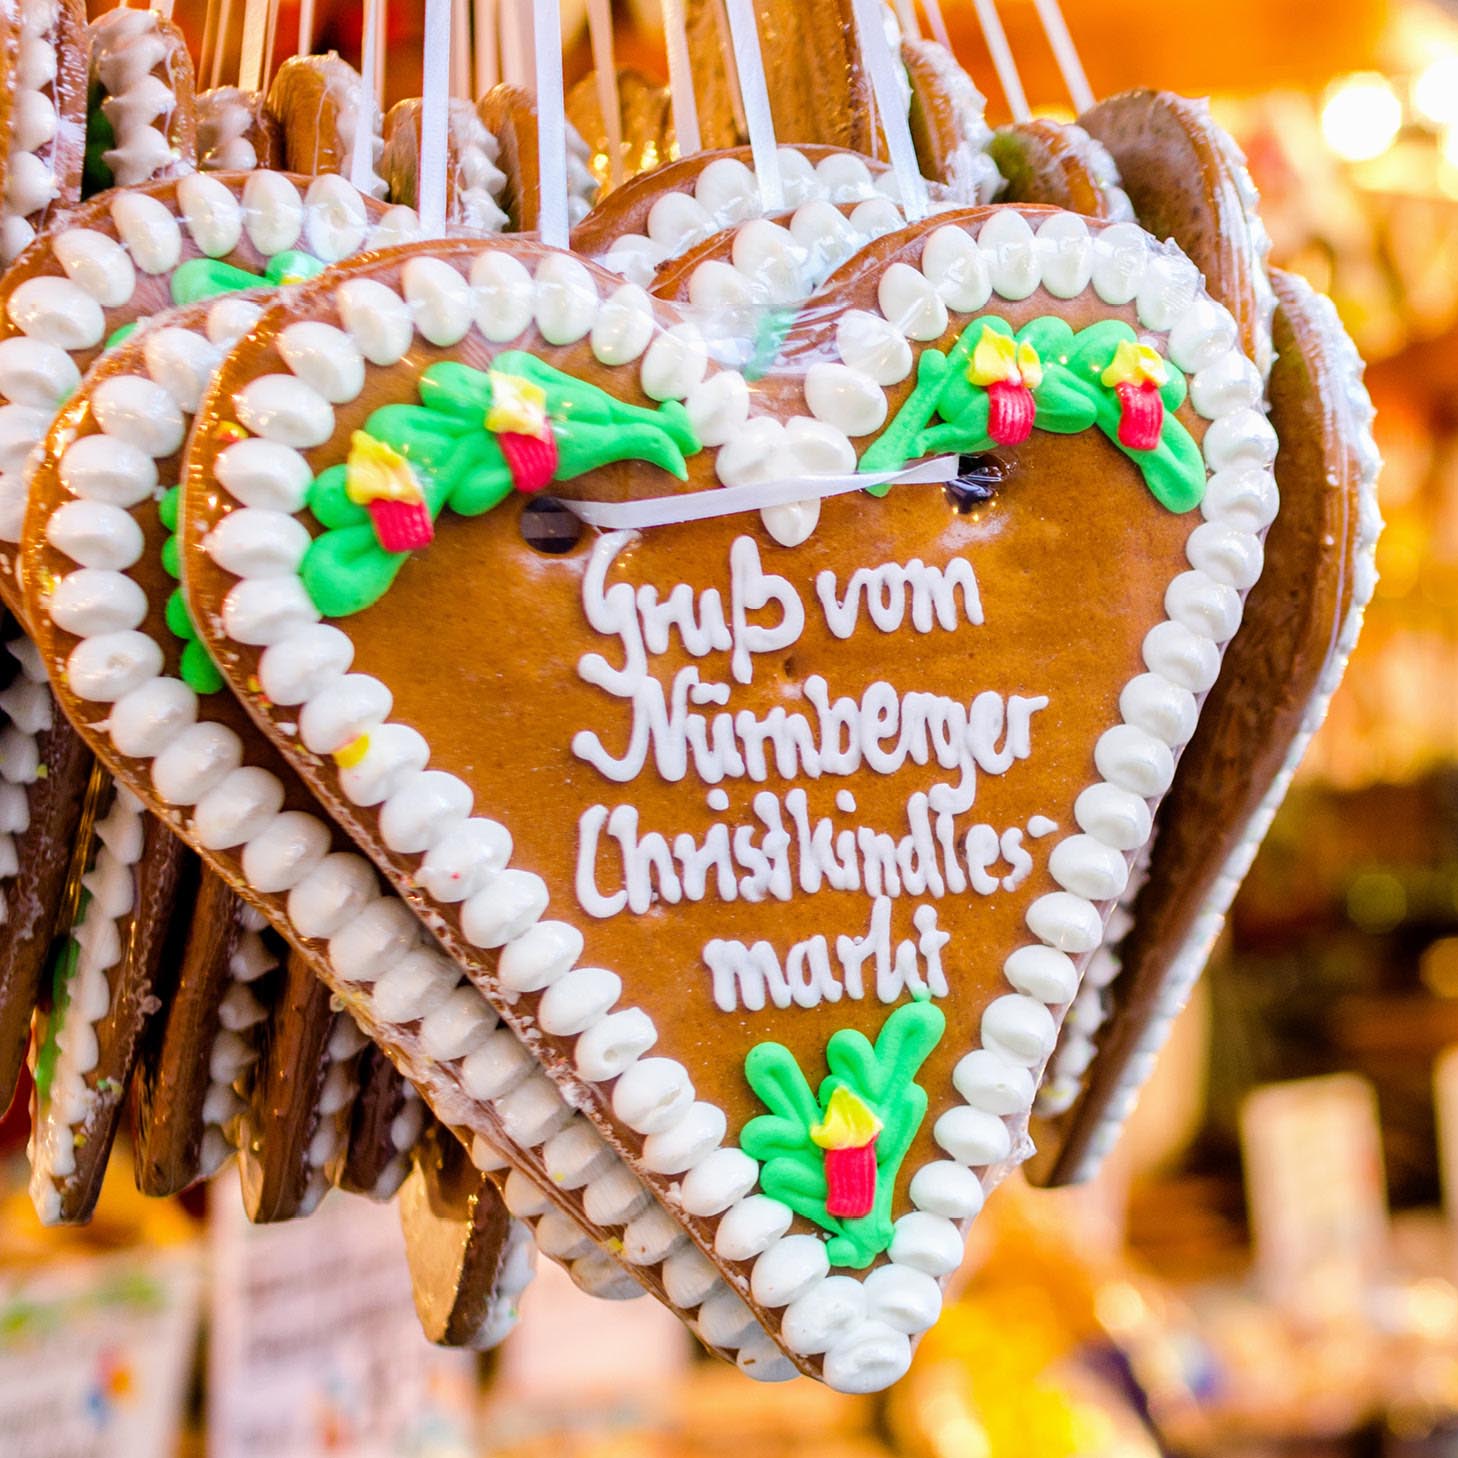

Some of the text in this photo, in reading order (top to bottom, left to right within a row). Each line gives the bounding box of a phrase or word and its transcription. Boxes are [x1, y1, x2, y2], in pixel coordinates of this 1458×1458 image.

[578, 529, 984, 697] Gruß vom
[572, 666, 1050, 814] Nürnberger
[703, 896, 950, 1013] markt
